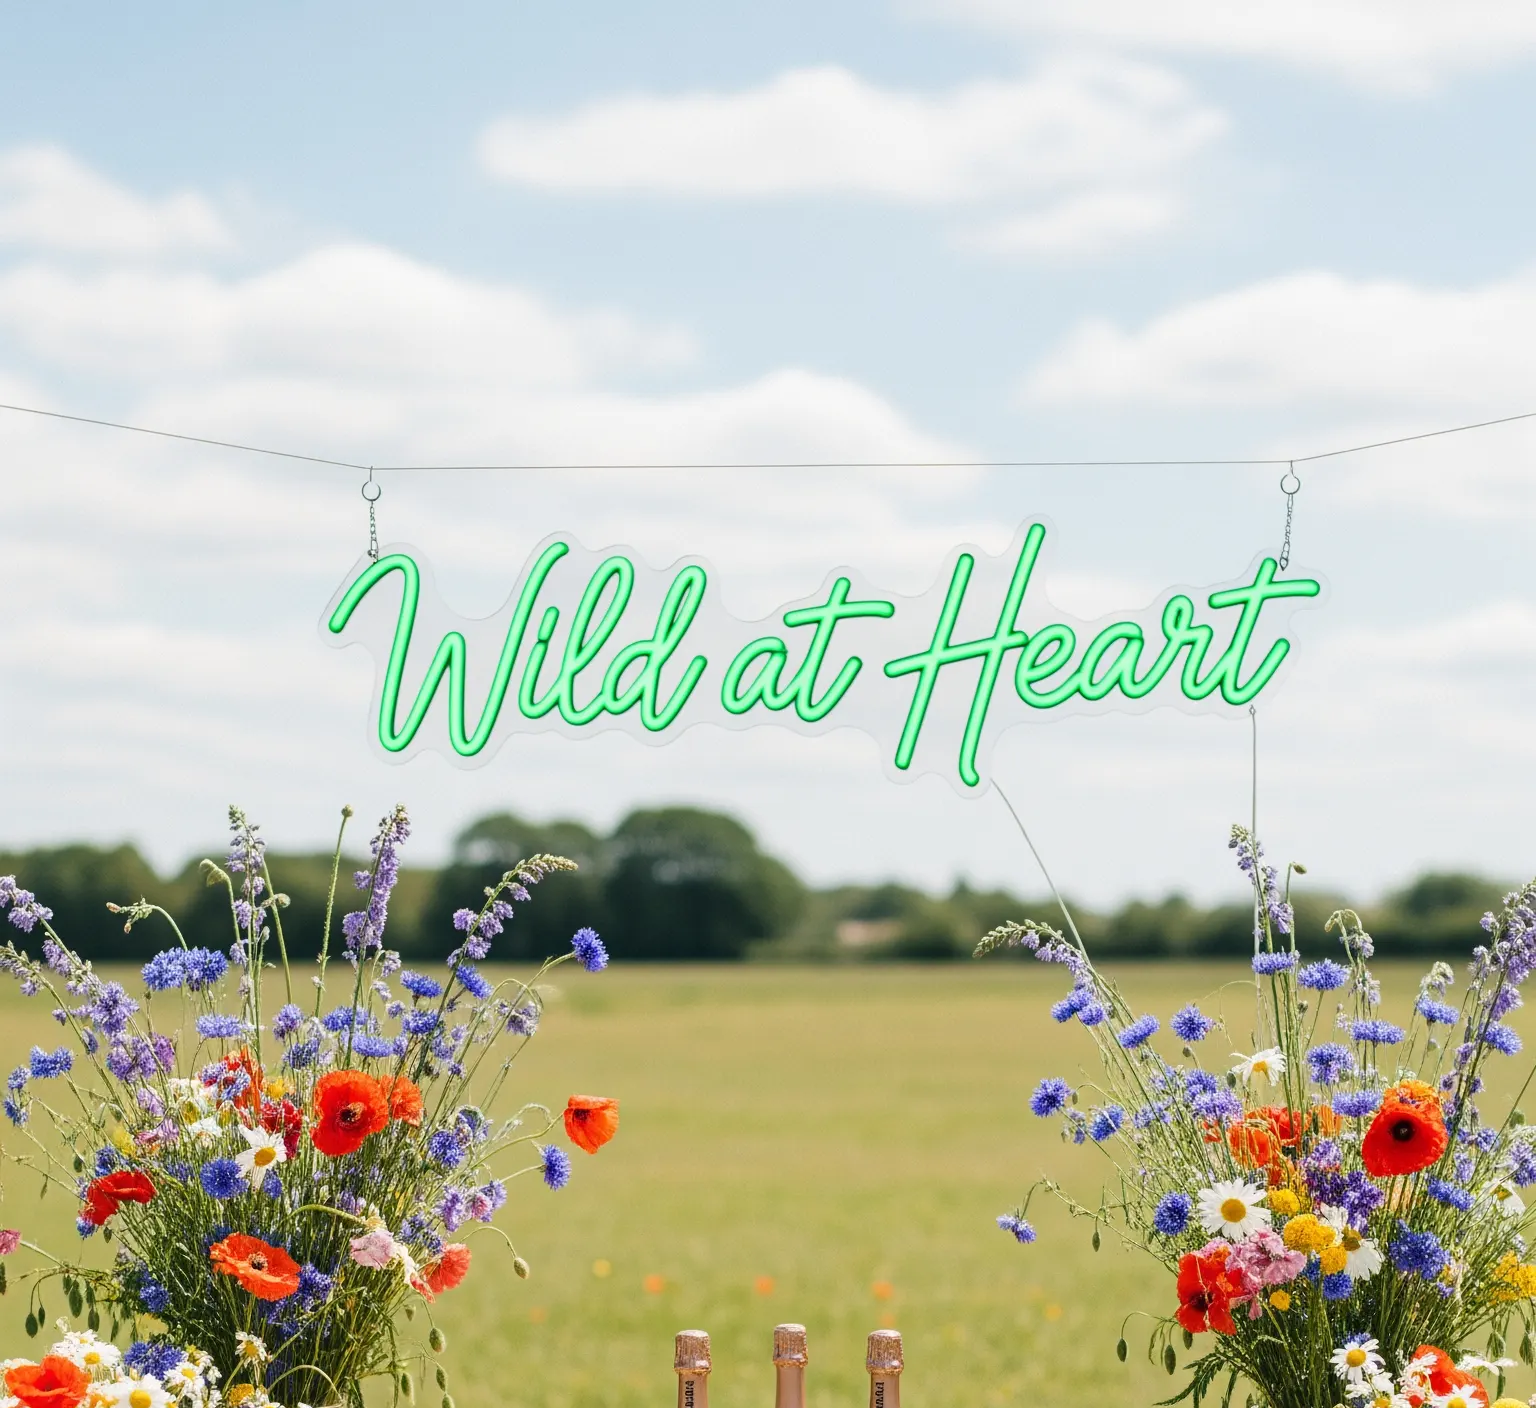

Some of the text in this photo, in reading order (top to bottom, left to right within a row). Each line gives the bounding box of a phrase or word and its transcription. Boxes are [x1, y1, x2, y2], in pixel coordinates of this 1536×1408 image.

[327, 522, 1321, 788] Wild at Heart
